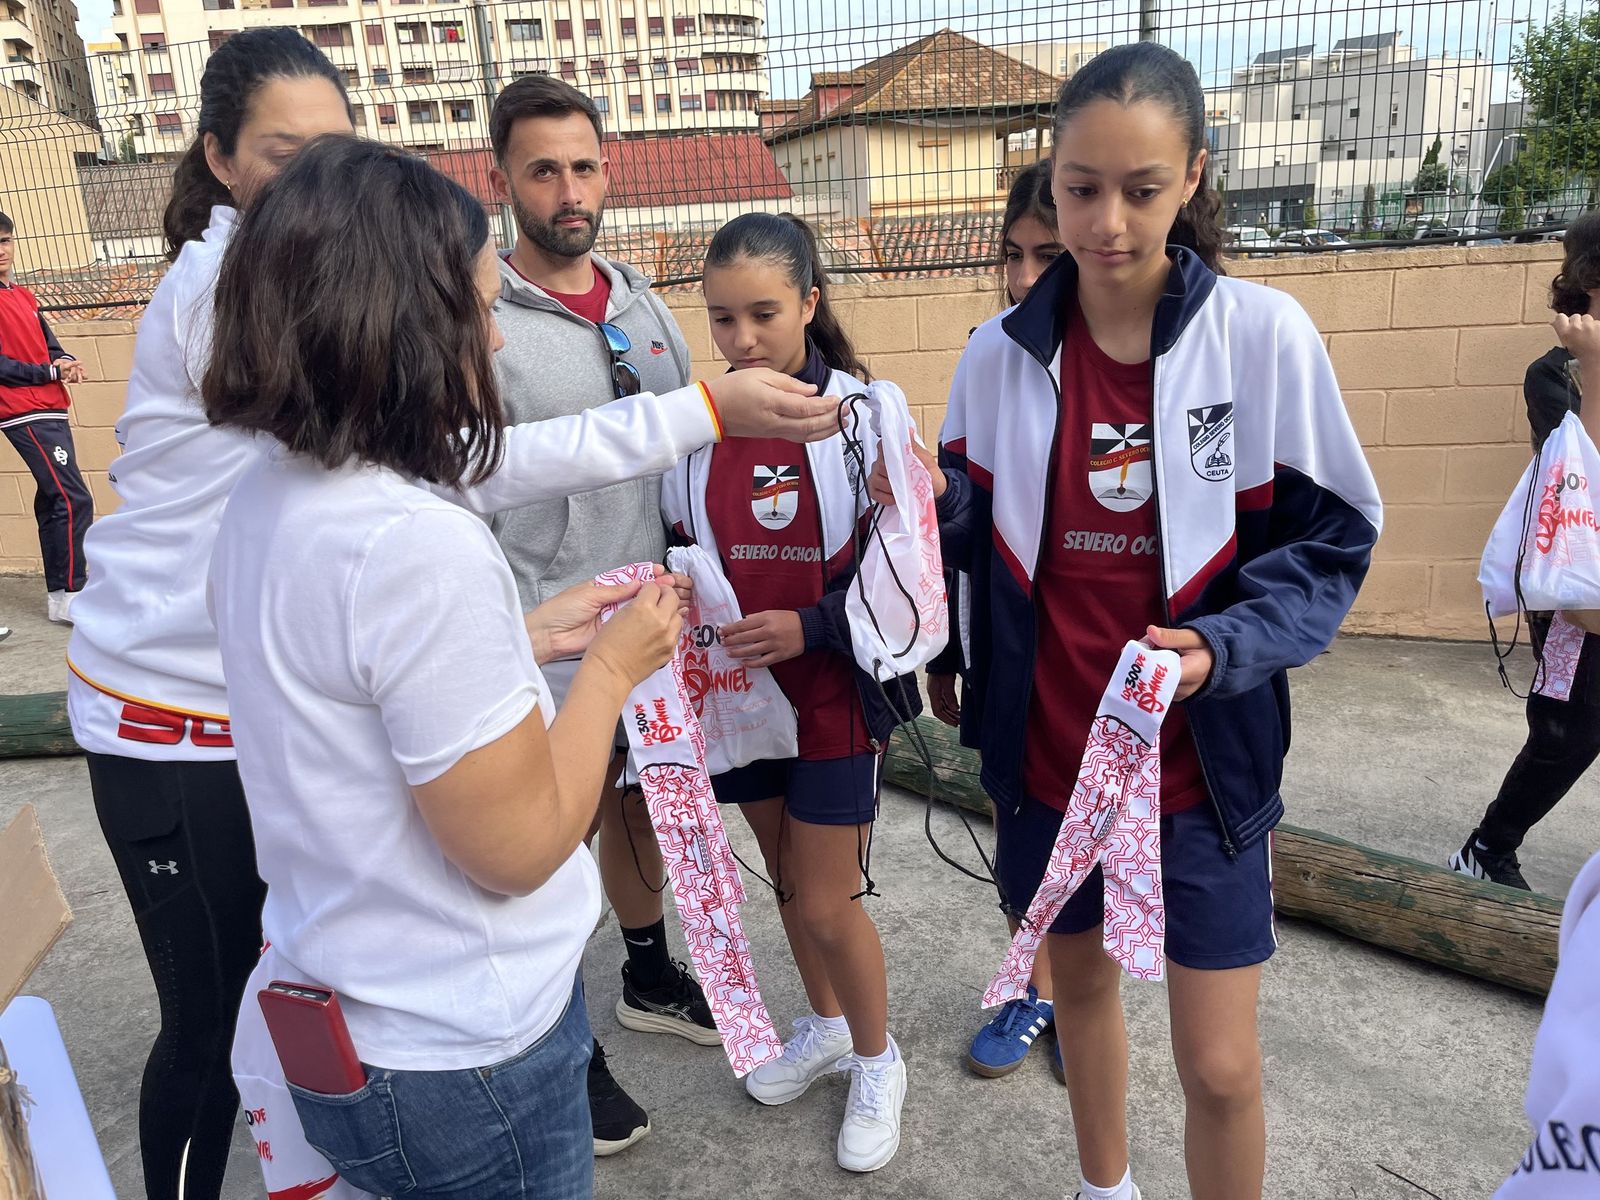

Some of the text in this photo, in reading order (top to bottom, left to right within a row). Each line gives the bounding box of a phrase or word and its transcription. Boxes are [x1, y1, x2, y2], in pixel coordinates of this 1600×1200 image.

[1192, 434, 1210, 450] COLEGIO
[1209, 421, 1224, 437] SEVERO
[1118, 449, 1140, 461] SEVERO
[1206, 469, 1229, 477] CEUTA
[730, 544, 822, 562] SEVERO OCHOA
[1063, 530, 1159, 556] SEVERO OC
[1125, 664, 1141, 688] 300
[1137, 663, 1168, 714] DANIEL
[635, 713, 650, 735] 300
[652, 696, 682, 744] DANIEL
